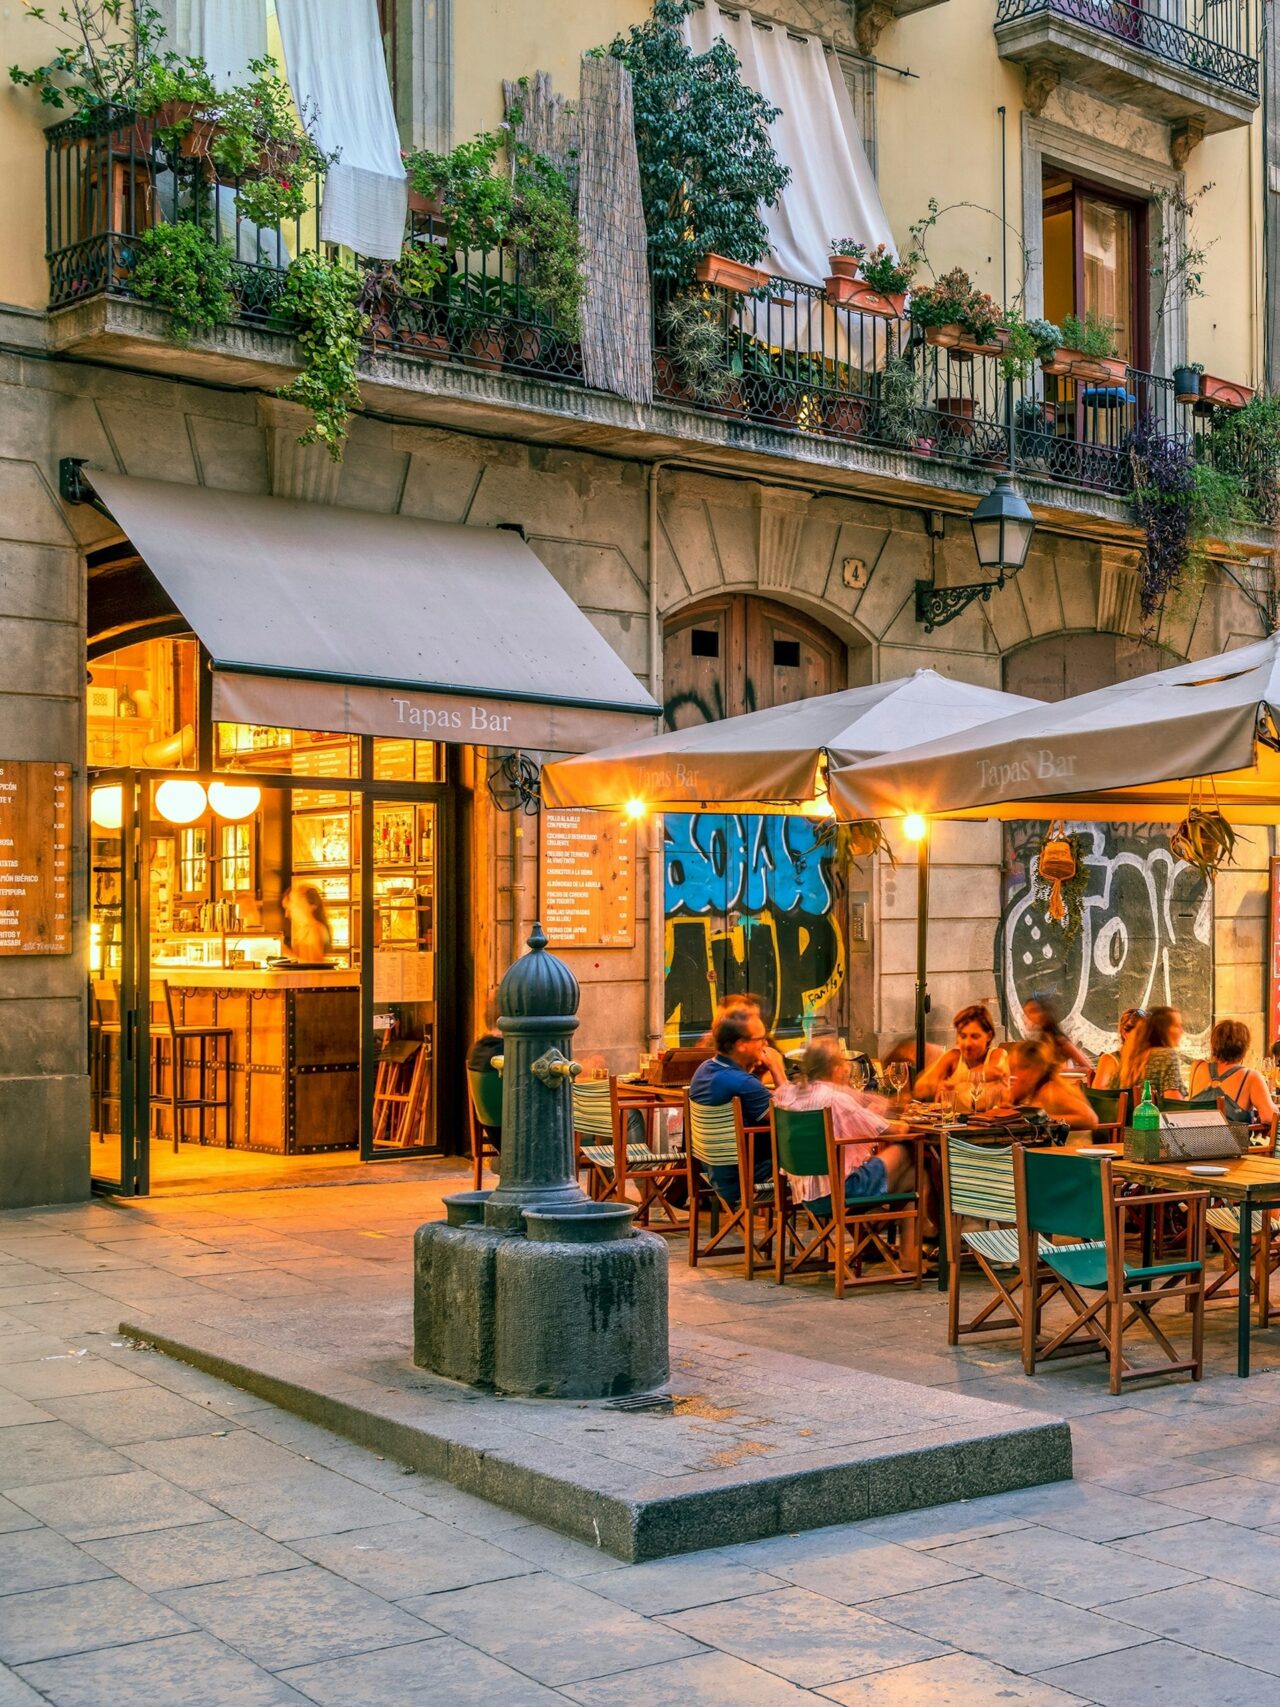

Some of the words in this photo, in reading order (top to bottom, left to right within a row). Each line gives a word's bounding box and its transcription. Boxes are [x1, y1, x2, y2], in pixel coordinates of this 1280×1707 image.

[851, 565, 859, 581] 4
[393, 699, 461, 732] Tapas
[469, 706, 511, 731] Bar
[638, 766, 672, 795] Tapas
[676, 763, 700, 788] Bar
[976, 760, 1031, 793] Tapas
[1037, 749, 1077, 779] Bar
